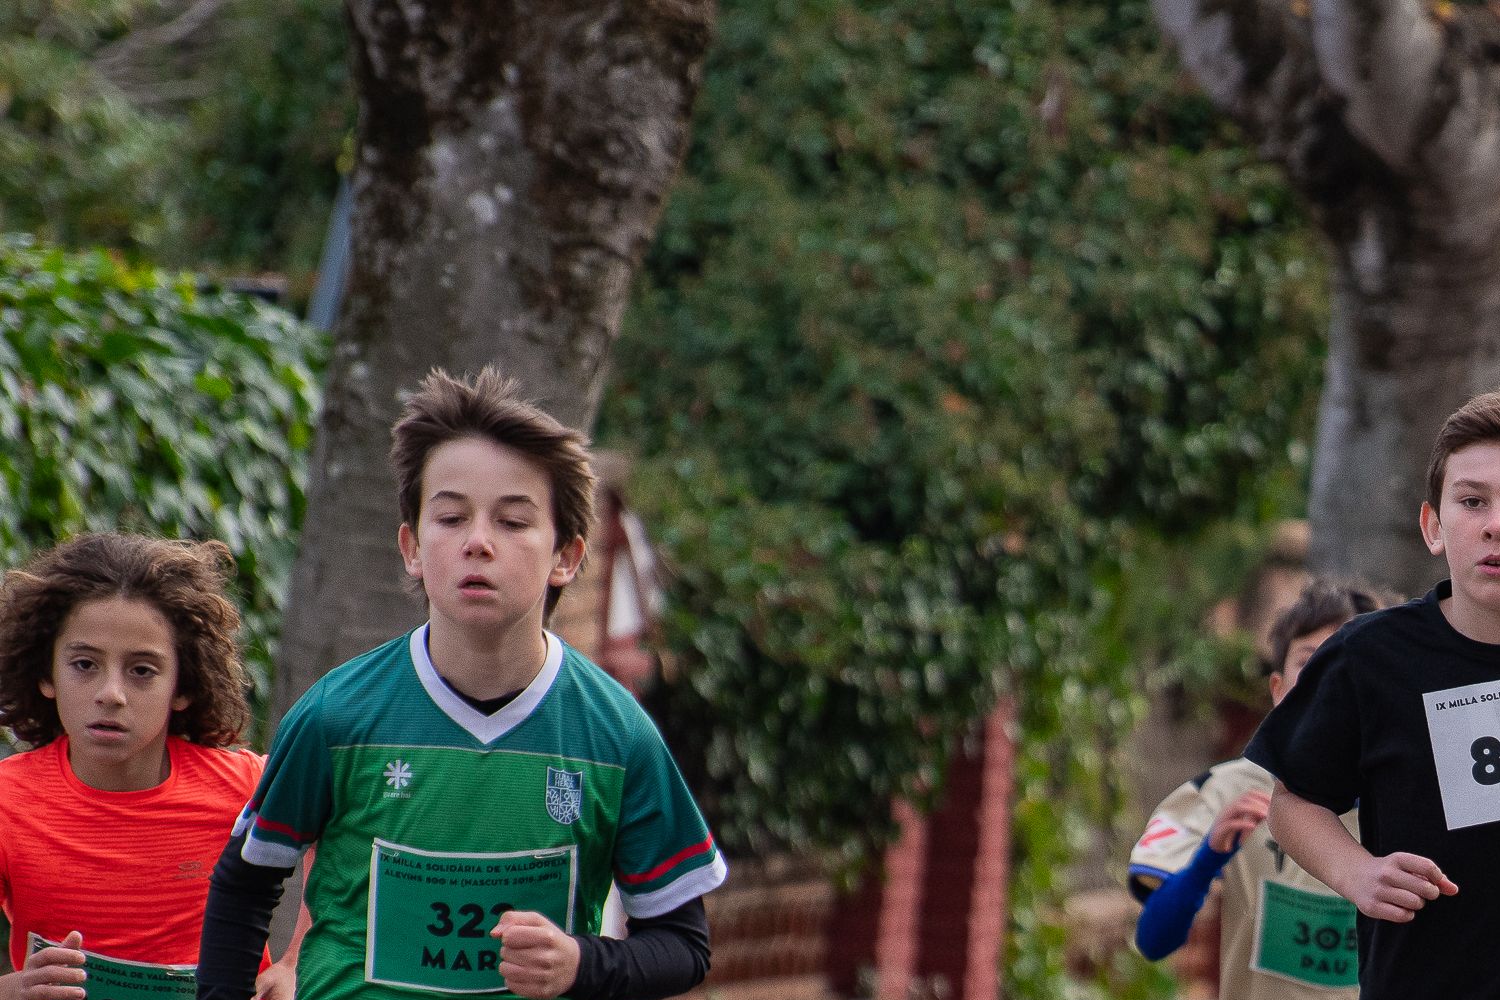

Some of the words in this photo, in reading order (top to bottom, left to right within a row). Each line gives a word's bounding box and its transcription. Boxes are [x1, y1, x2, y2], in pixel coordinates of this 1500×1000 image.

[1435, 703, 1446, 711] IX
[1449, 696, 1478, 709] MILLA
[381, 853, 390, 864] IX
[393, 857, 422, 870] MILLA
[426, 862, 482, 873] SOLIDÀRIA
[486, 865, 500, 873] DE
[505, 858, 568, 873] VALLDOREIX
[384, 868, 422, 882] ALEVINS
[450, 878, 457, 886] M
[427, 902, 515, 938] 32
[1300, 955, 1348, 975] PAU
[130, 971, 143, 979] DE
